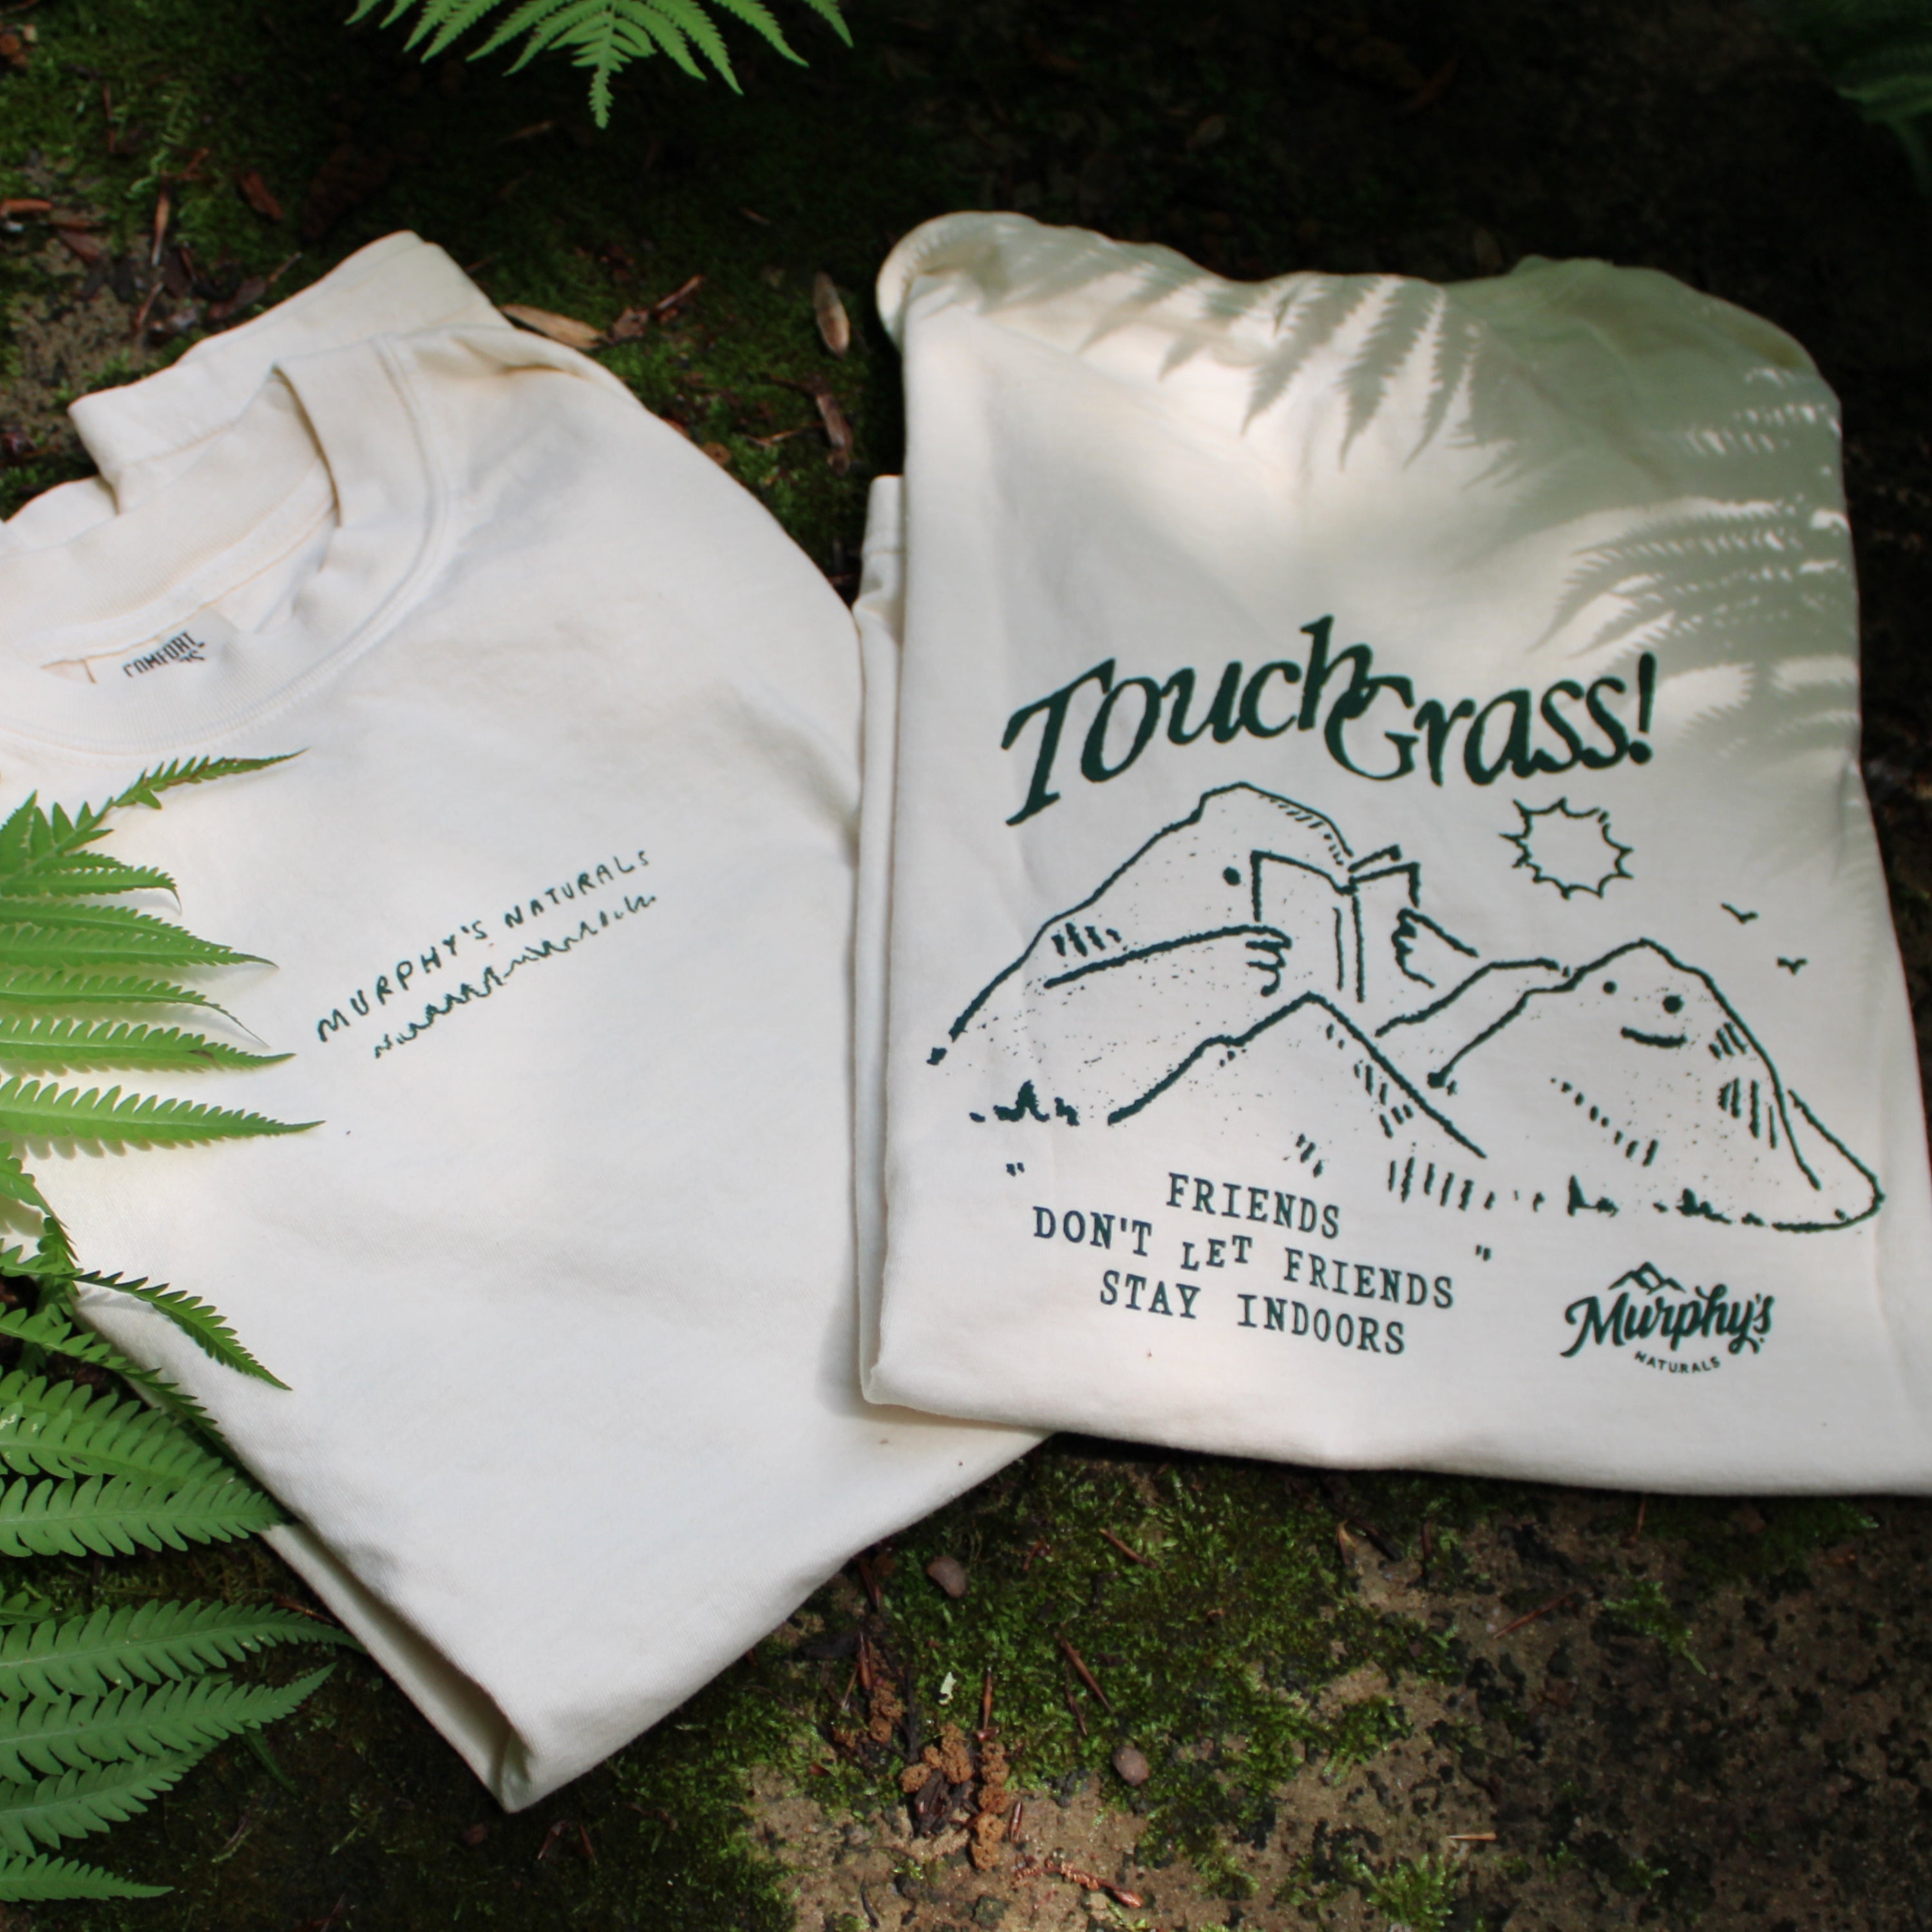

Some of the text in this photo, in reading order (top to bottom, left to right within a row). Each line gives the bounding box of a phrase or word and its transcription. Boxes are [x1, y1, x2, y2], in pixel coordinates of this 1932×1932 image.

[1001, 615, 1656, 825] Touch Grass!
[317, 850, 649, 1043] MURPHY'S NATURALS
[1166, 1172, 1340, 1240] FRIENDS
[1032, 1206, 1454, 1309] DON'T LET FRIENDS
[1100, 1269, 1405, 1355] STAY INDOORS
[1559, 1284, 1775, 1357] Murphy's
[1634, 1350, 1721, 1374] NATURALS
